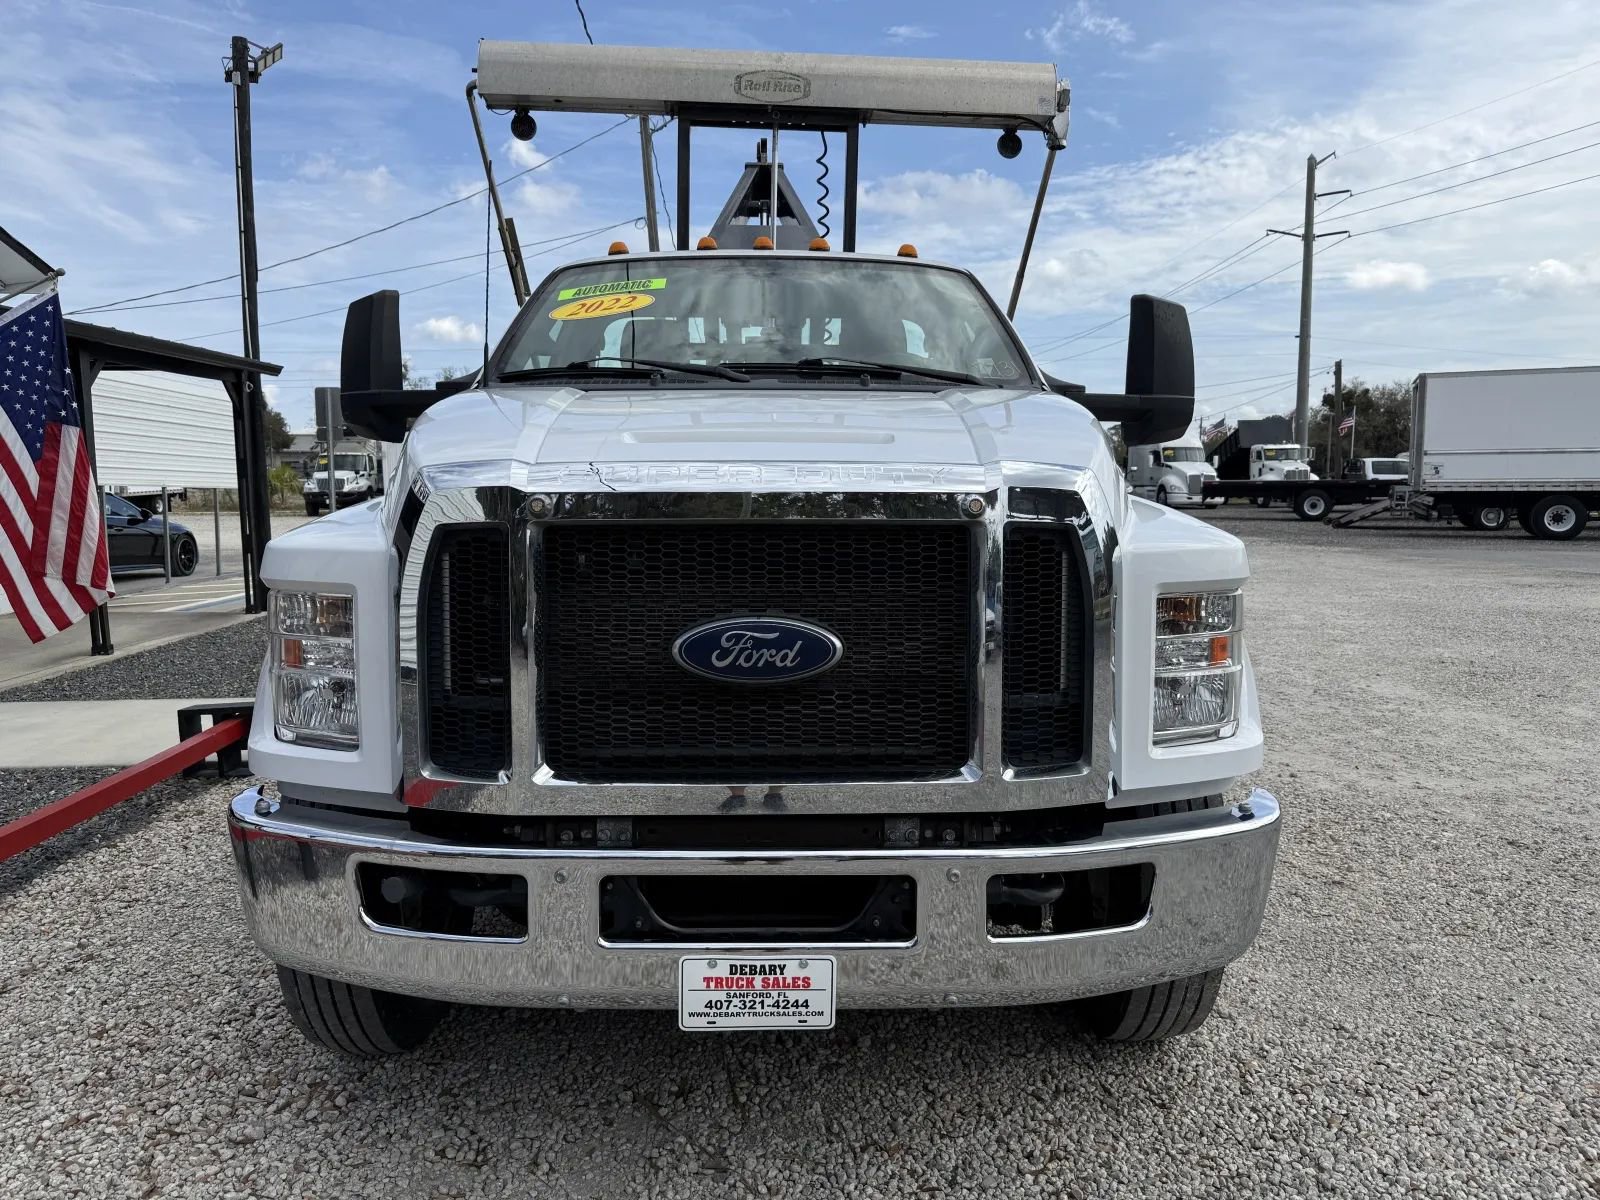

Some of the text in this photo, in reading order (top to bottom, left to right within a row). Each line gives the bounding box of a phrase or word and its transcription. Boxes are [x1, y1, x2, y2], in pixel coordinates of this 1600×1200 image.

[572, 280, 653, 297] AUTOMATIC
[566, 296, 637, 317] 2022
[558, 465, 953, 484] SUPER DUTY
[711, 630, 803, 668] Ford
[729, 964, 787, 976] DEBARY
[703, 976, 811, 989] TRUCK SALES
[725, 992, 775, 1000] SANFORD,
[704, 999, 810, 1010] 407-321-4244
[688, 1010, 825, 1018] WWW.DEBARYTRUCKSALES.COM
